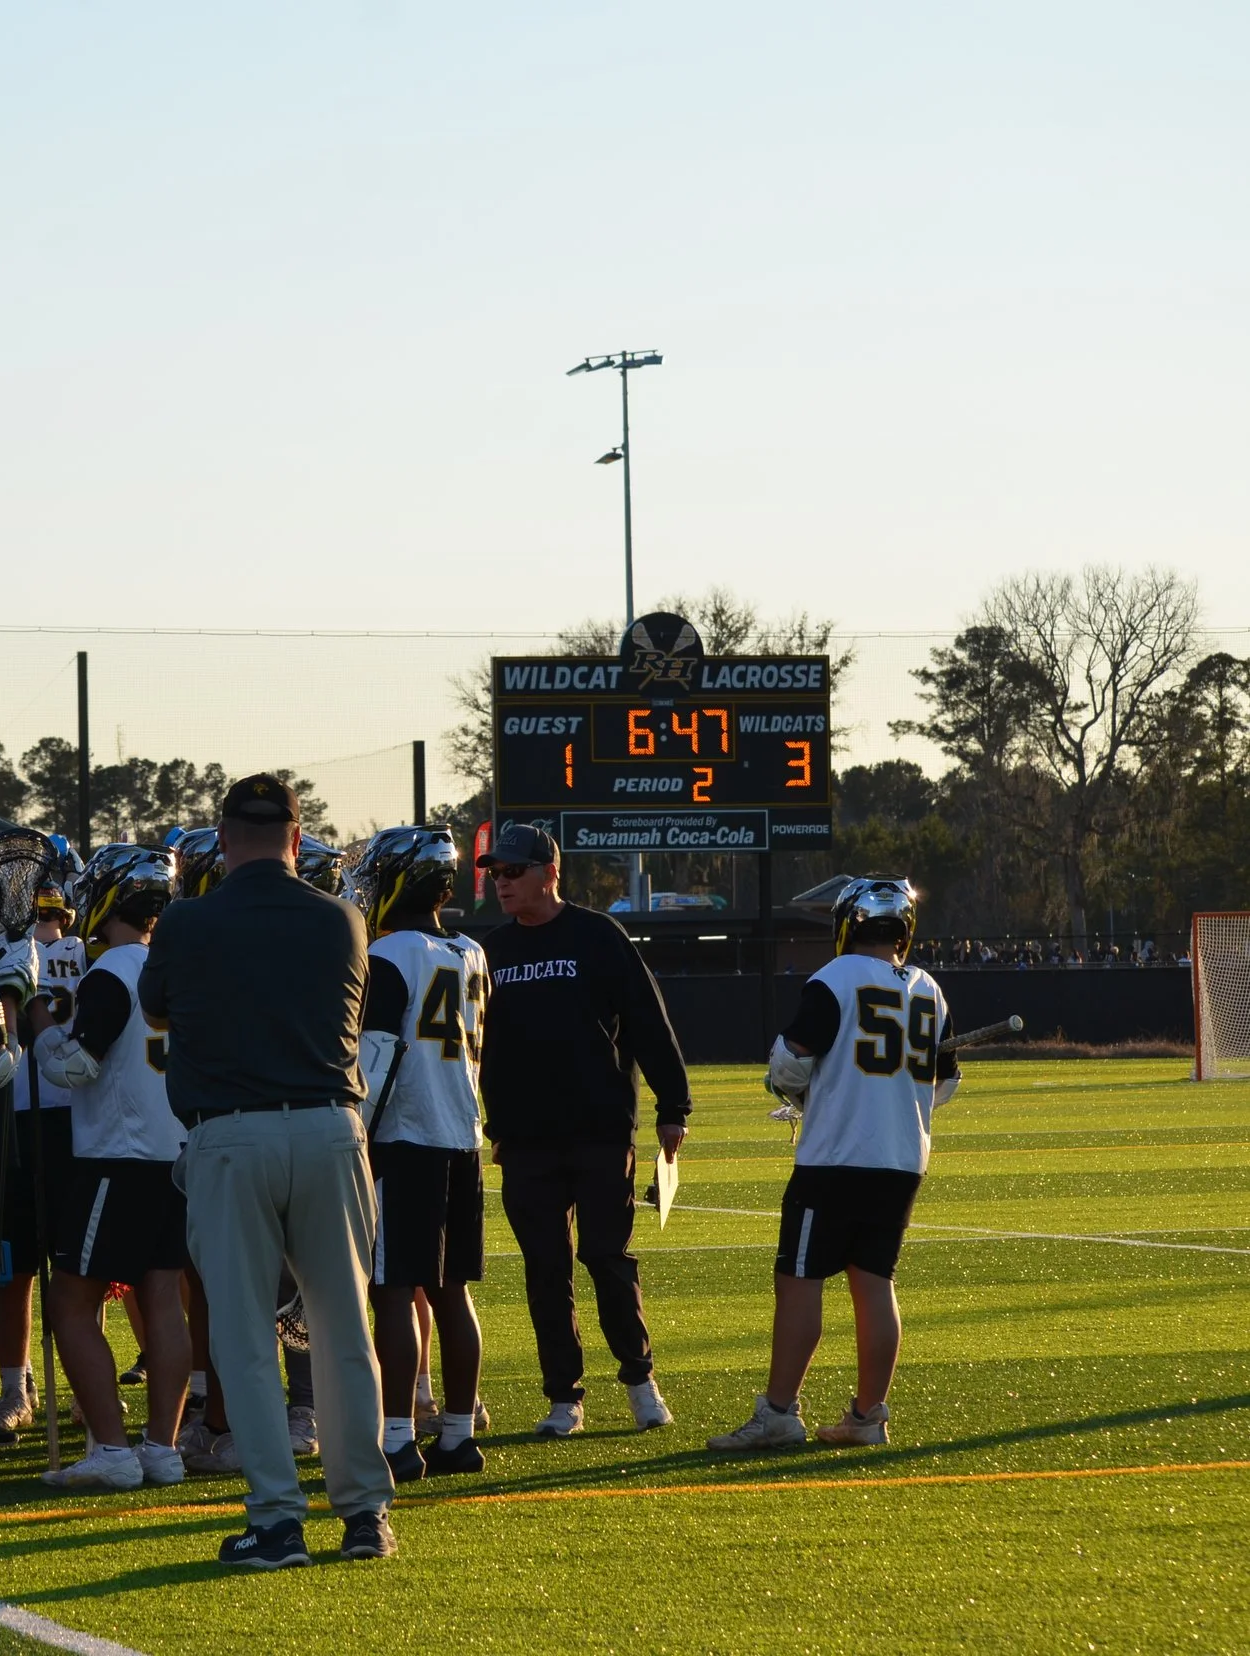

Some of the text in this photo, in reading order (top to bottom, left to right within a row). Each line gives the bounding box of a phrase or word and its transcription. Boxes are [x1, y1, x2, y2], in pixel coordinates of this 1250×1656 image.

[504, 665, 823, 690] WILDCAT LACROSSE
[504, 717, 583, 735] GUEST
[628, 709, 728, 755] 6:47
[738, 715, 826, 733] WILDCATS
[565, 743, 573, 788] 1
[784, 741, 811, 787] 3
[613, 778, 684, 793] PERIOD
[692, 767, 713, 802] 2
[612, 816, 718, 829] Scoreboard Provided By
[771, 824, 829, 834] POWERADE
[576, 827, 661, 846] Savannah
[666, 826, 755, 845] Coca-Cola
[493, 960, 577, 988] WILDCATS
[853, 984, 937, 1085] 59
